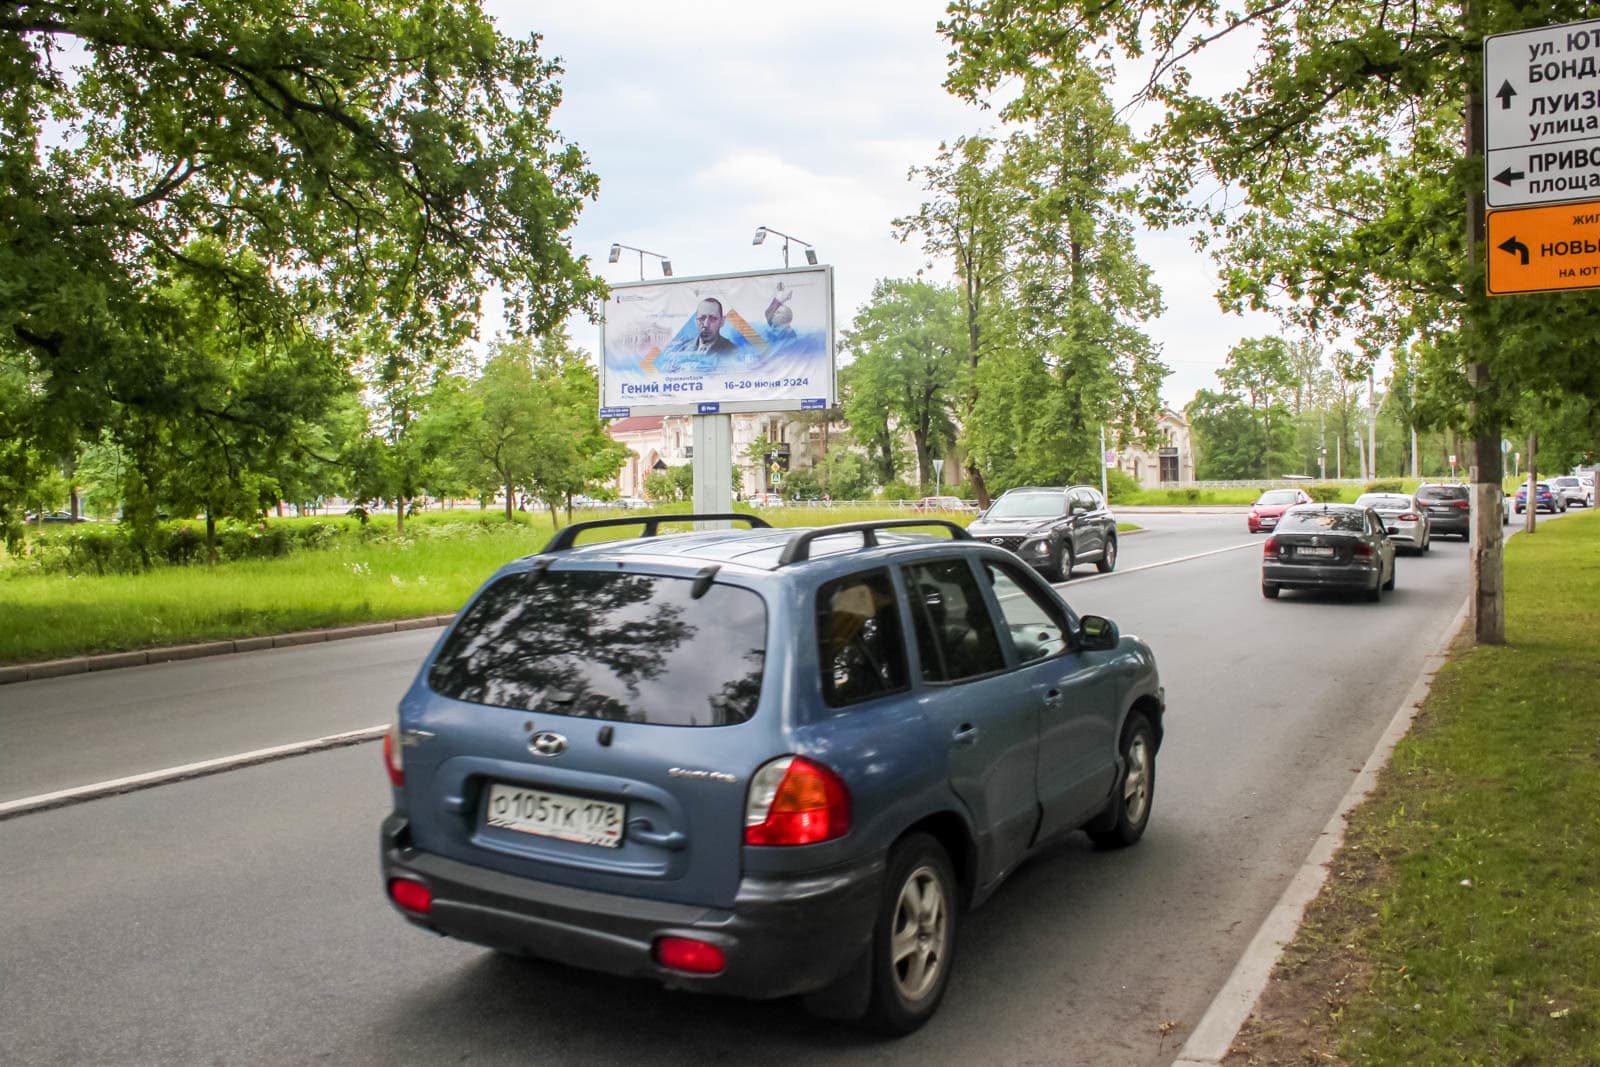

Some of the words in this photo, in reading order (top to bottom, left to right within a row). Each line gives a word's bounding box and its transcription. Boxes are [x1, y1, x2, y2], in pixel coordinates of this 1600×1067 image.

[1528, 41, 1561, 63] ул.
[1567, 28, 1600, 52] ЮТ
[1528, 56, 1600, 83] БОНД
[1528, 89, 1600, 117] ЛУИЗ
[1529, 115, 1598, 142] улица
[1529, 173, 1600, 194] площа
[1559, 268, 1576, 278] НА
[621, 381, 659, 394] Гений
[663, 381, 703, 392] места
[754, 380, 781, 389] июня
[783, 377, 809, 387] 2024
[583, 802, 617, 827] 178
